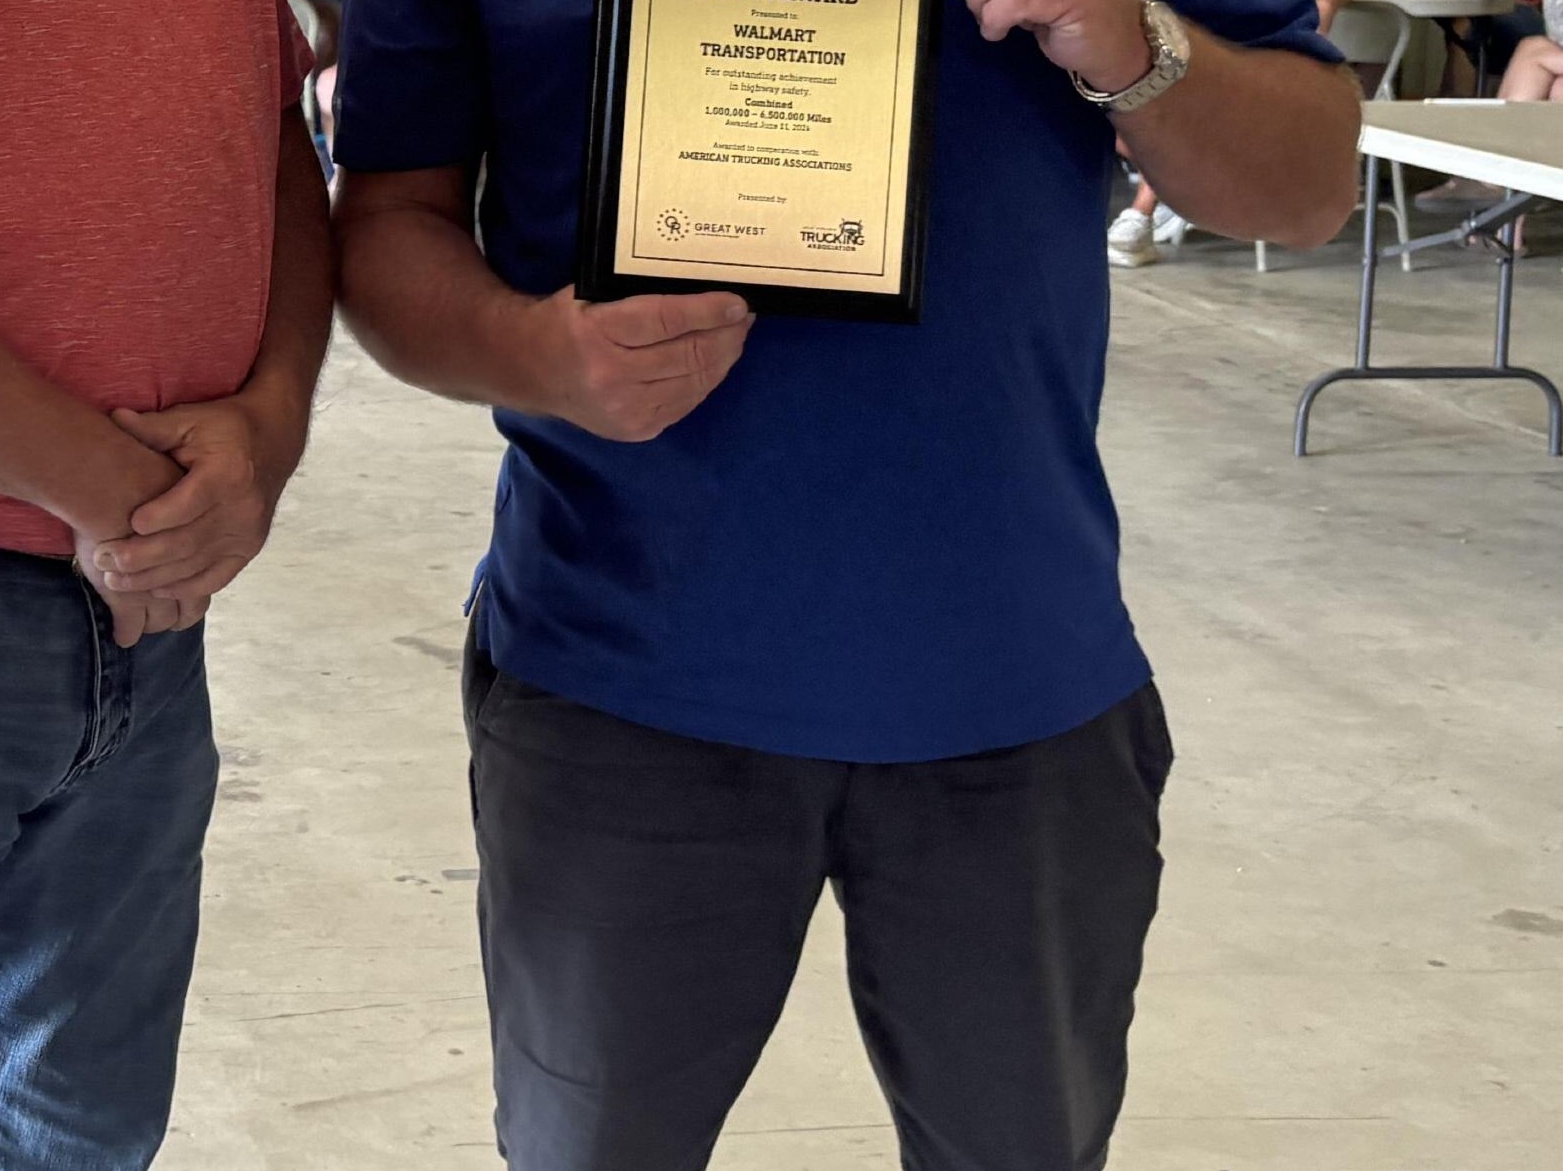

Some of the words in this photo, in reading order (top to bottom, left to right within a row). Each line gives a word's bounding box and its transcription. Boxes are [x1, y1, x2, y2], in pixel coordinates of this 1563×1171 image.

[734, 24, 816, 43] WALMART
[700, 42, 846, 65] TRANSPORTATION
[705, 67, 720, 76] For
[722, 70, 776, 81] outstanding
[779, 73, 837, 85] achievement
[729, 80, 739, 90] in
[740, 82, 780, 95] highway
[781, 86, 811, 97] safety.
[745, 97, 793, 109] Combined
[725, 119, 758, 128] Awarded
[807, 113, 832, 124] Miles
[678, 151, 730, 163] AMERICAN
[731, 154, 780, 166] TRUCKING
[782, 158, 852, 172] ASSOCIATIONS
[694, 222, 732, 233] GREAT
[734, 225, 767, 236] WEST
[799, 230, 865, 245] TRUCKING
